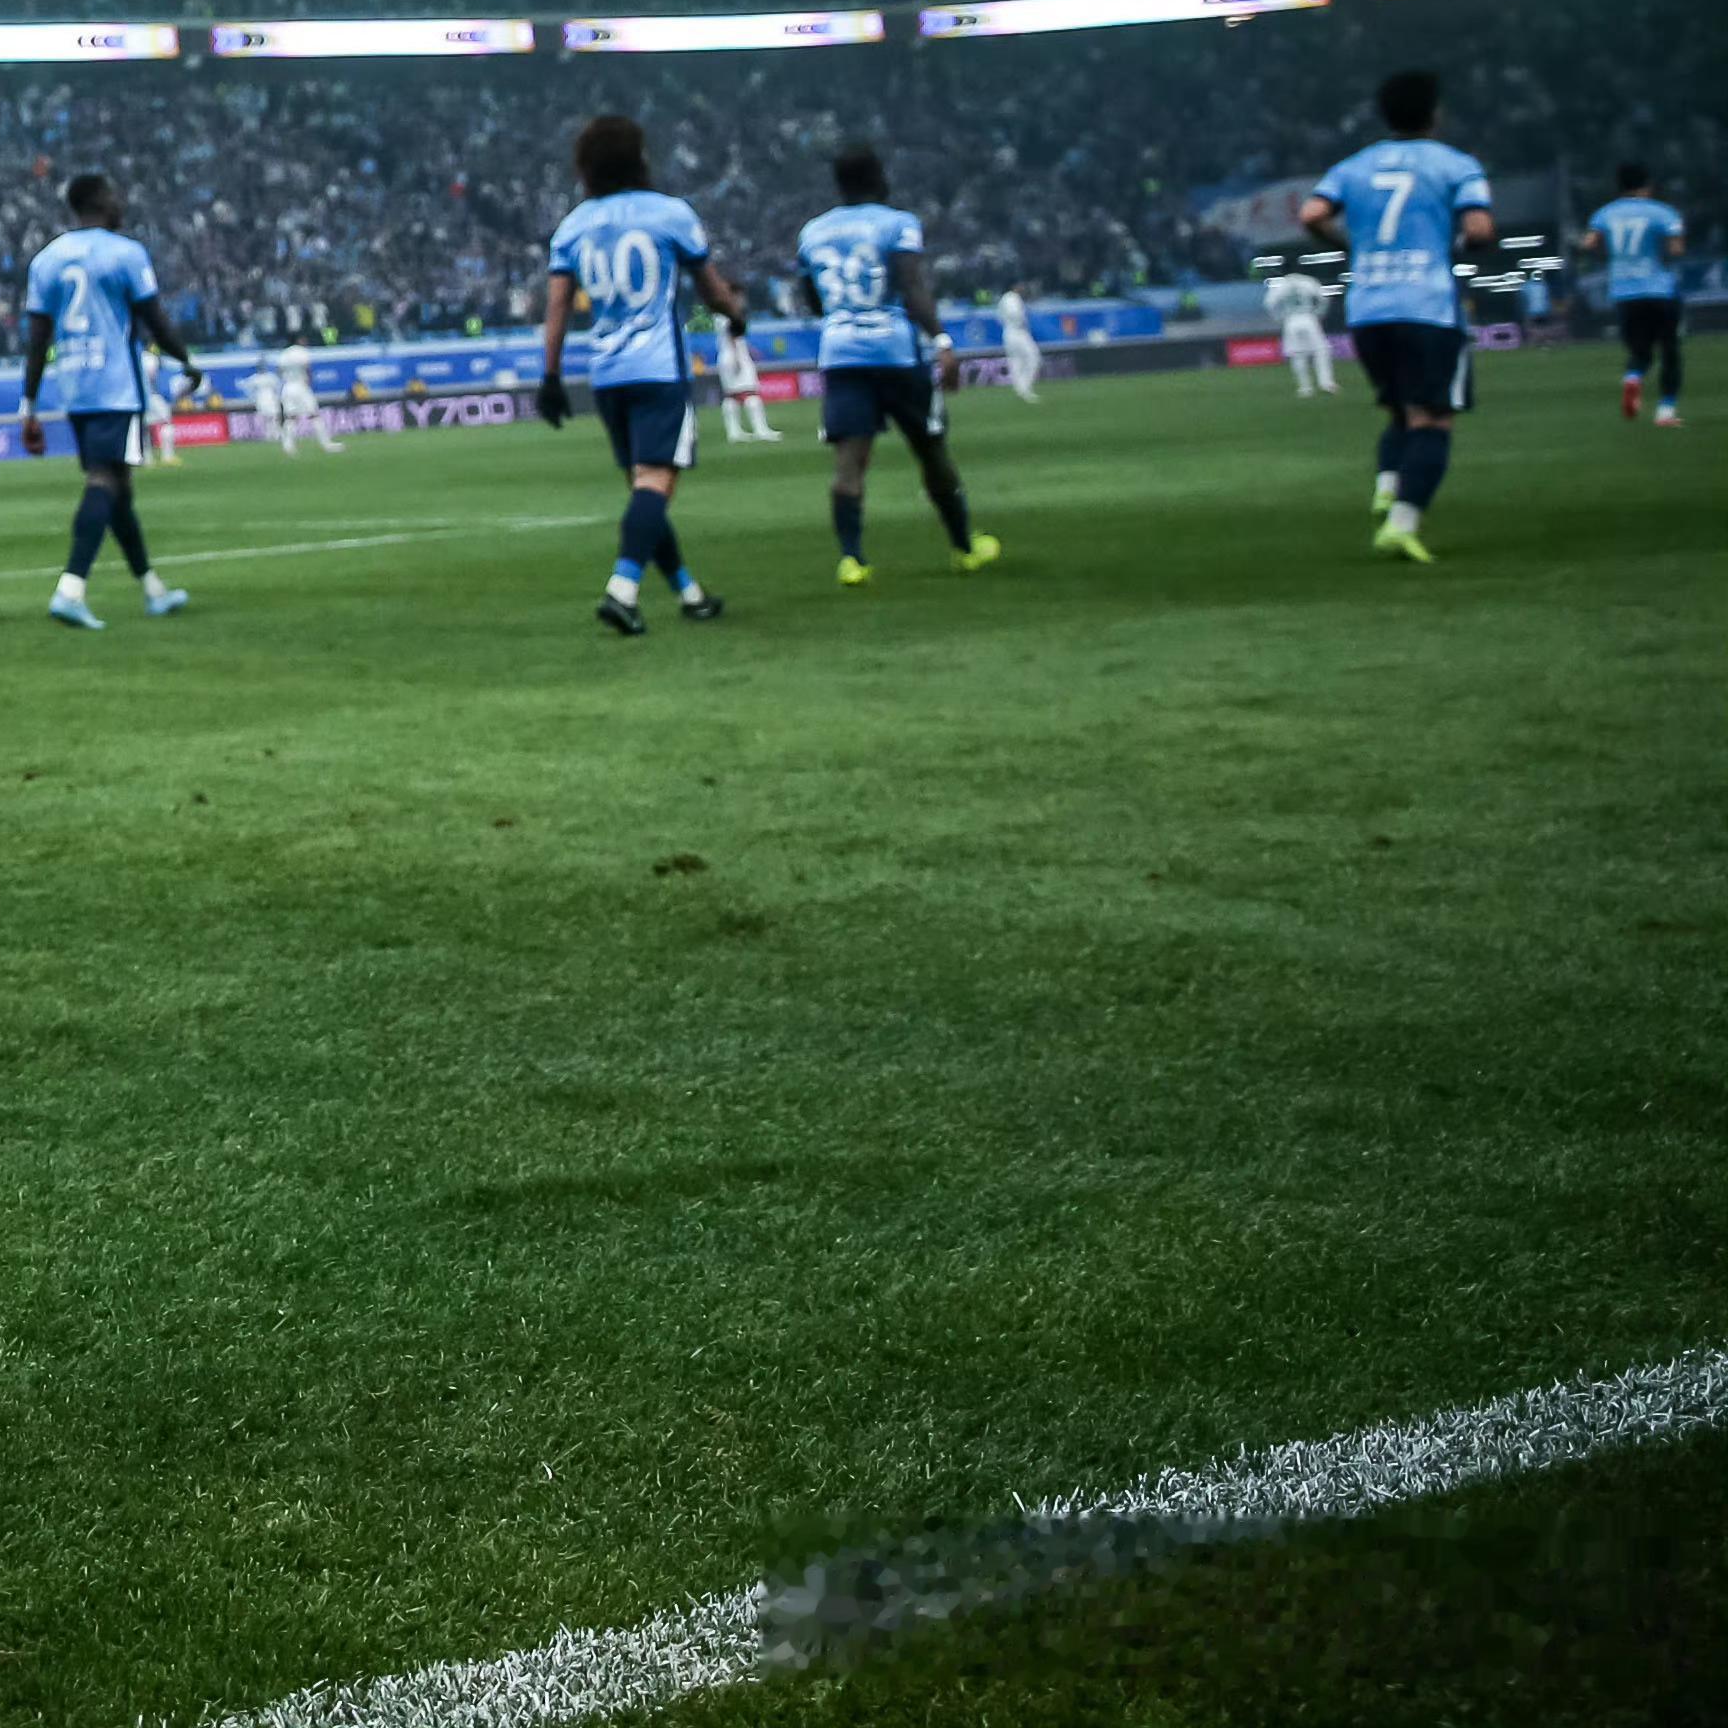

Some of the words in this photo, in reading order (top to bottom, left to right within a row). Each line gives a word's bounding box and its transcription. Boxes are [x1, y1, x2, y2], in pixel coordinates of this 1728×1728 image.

[1370, 171, 1416, 246] 7
[1609, 215, 1649, 257] 17
[61, 265, 91, 333] 2
[578, 229, 661, 309] 40
